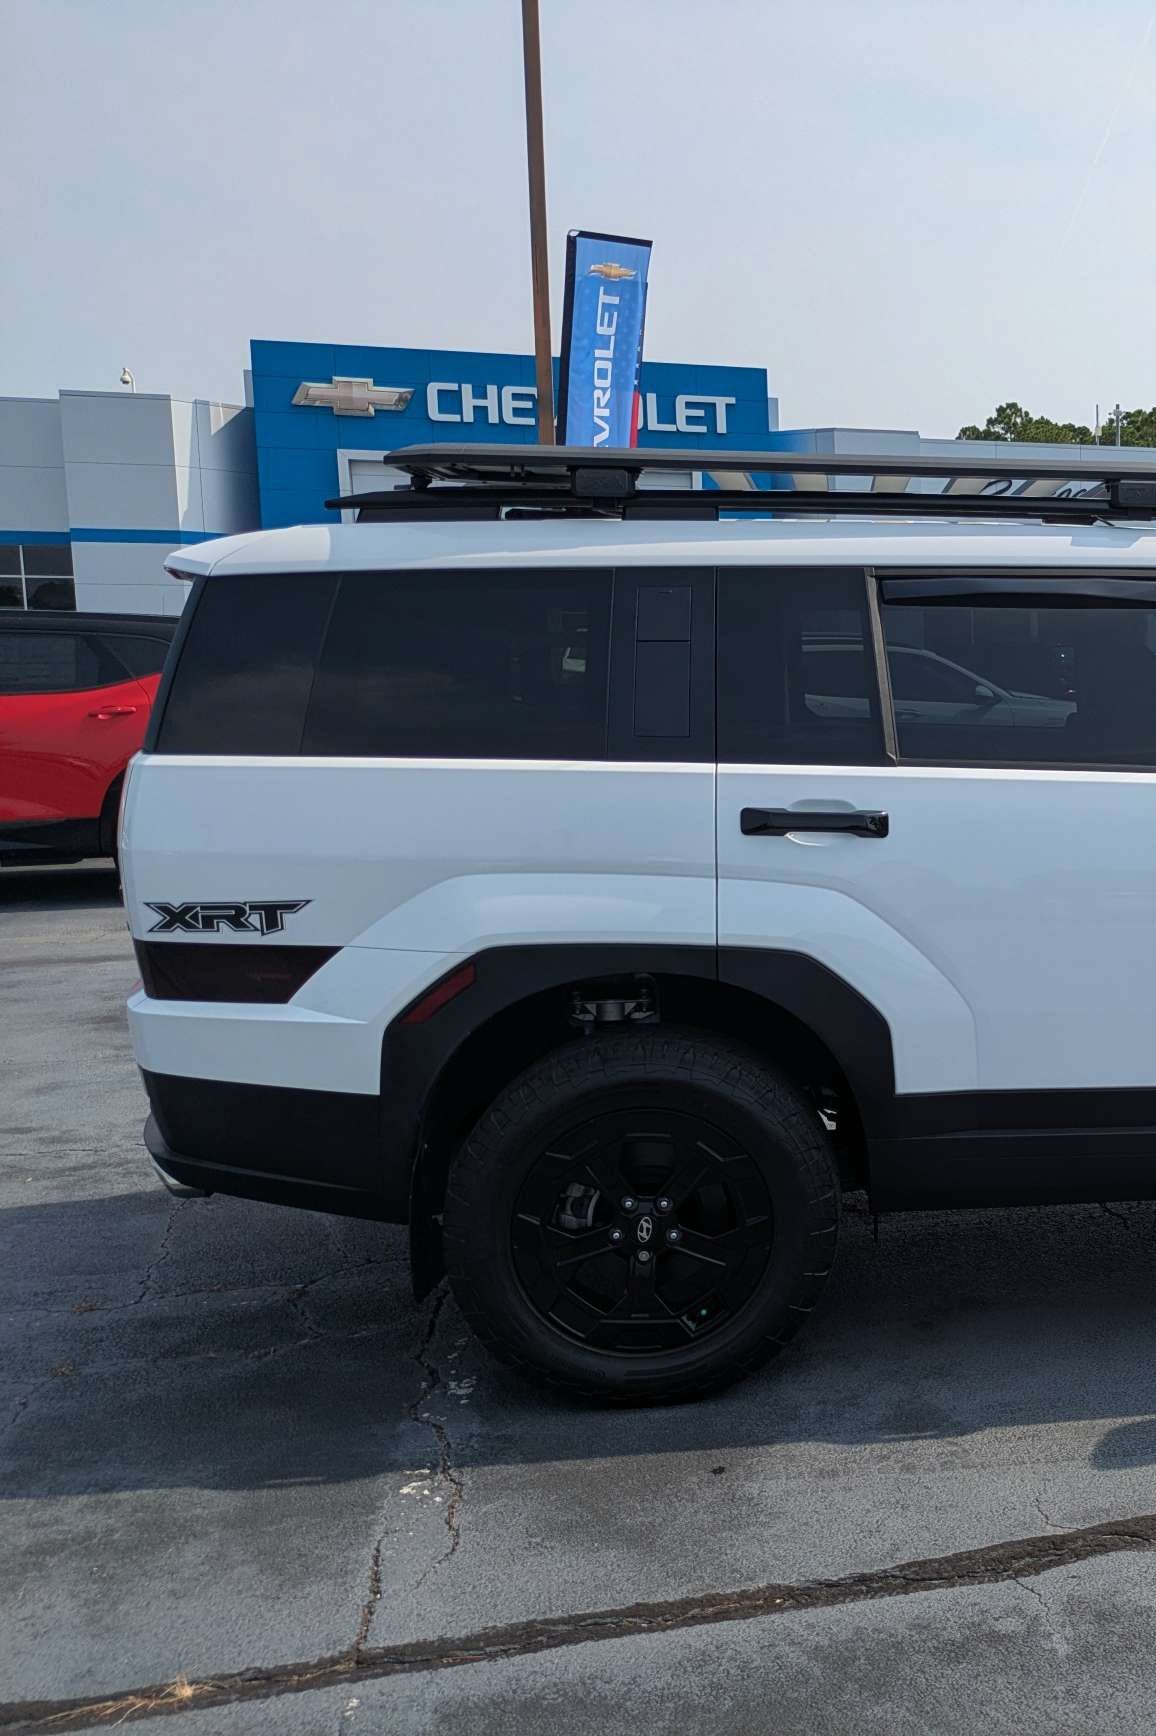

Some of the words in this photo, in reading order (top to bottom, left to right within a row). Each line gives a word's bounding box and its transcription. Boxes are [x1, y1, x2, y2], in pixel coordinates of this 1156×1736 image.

[593, 286, 620, 447] VROLET
[427, 382, 736, 433] CHELET
[143, 899, 314, 936] XRT
